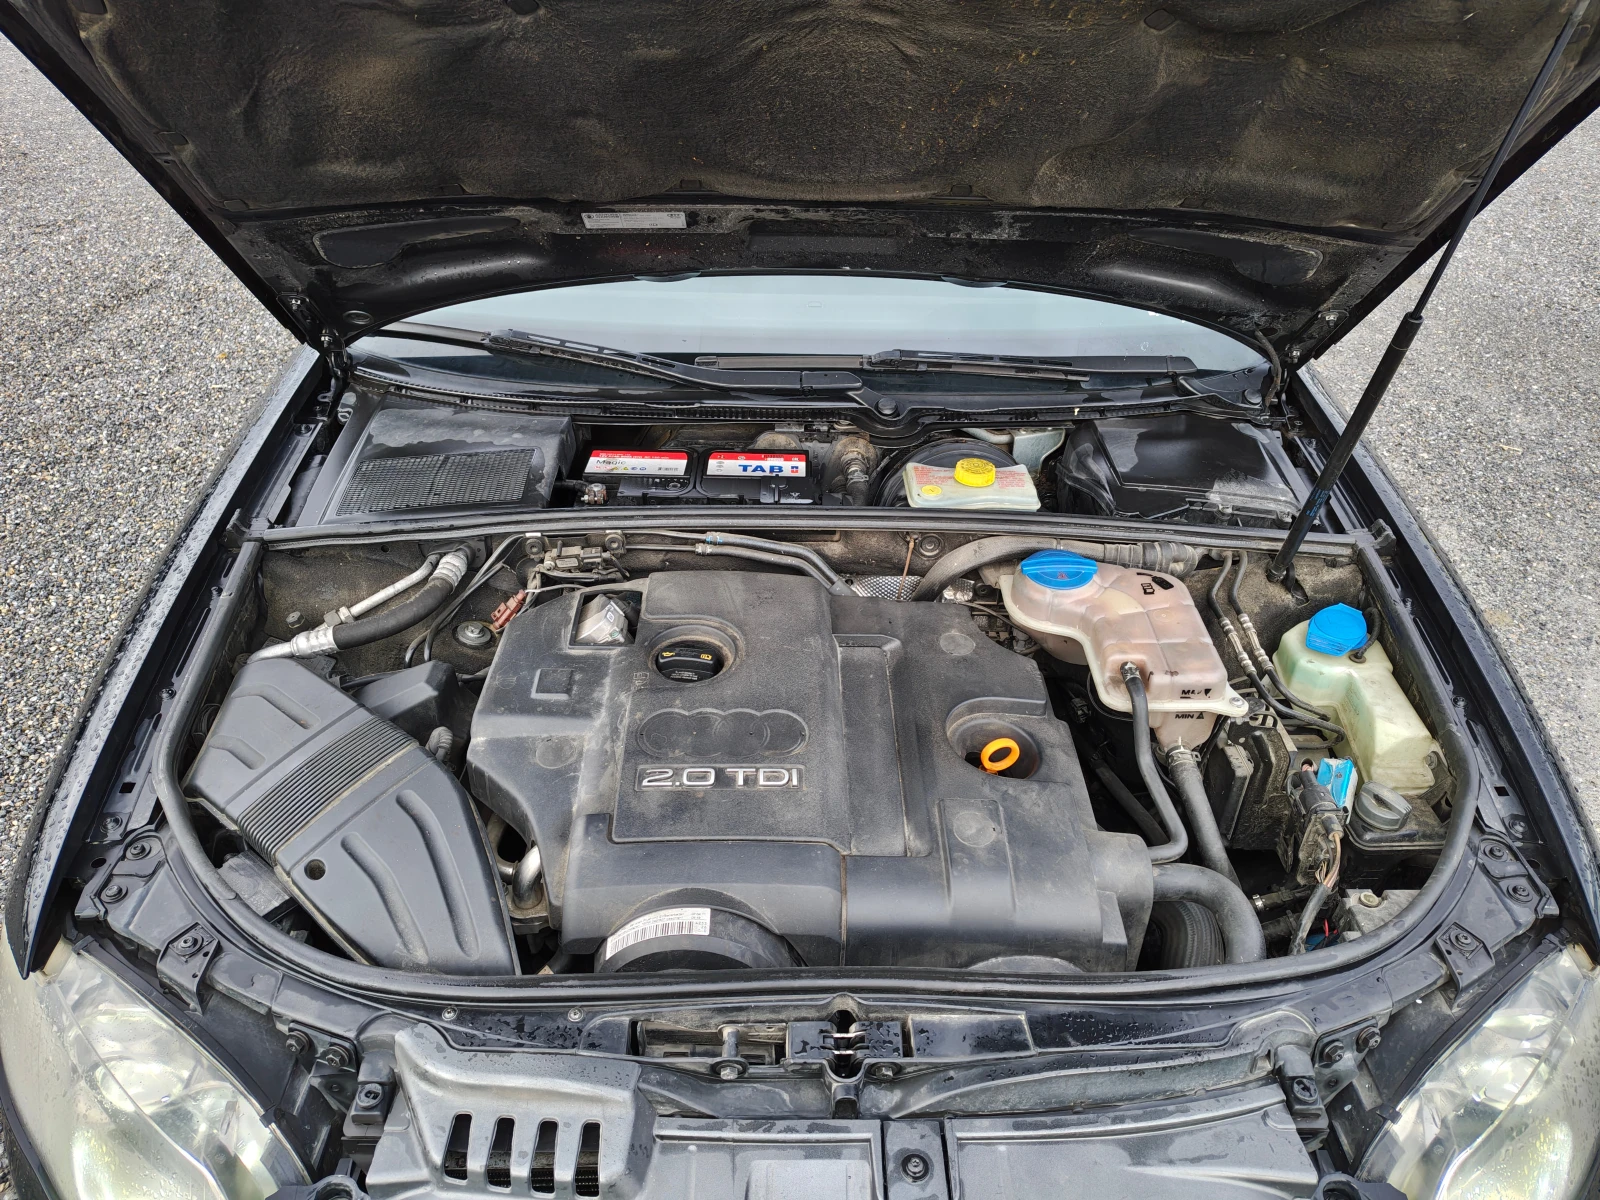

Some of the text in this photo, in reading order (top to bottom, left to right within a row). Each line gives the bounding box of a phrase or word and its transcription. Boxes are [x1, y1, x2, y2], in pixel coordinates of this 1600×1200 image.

[738, 464, 784, 474] TAB
[641, 767, 799, 787] 2.0 TDI
